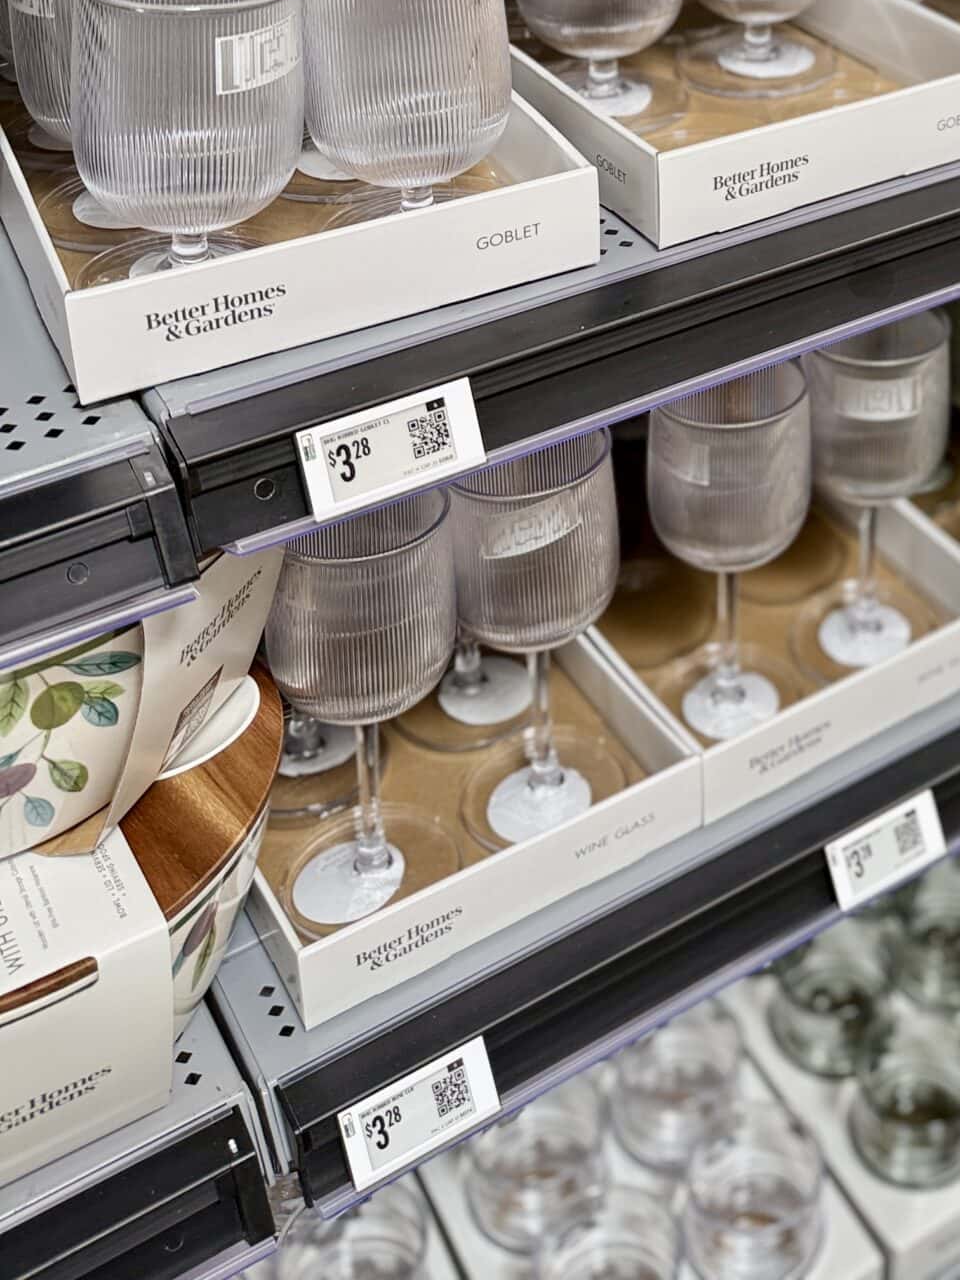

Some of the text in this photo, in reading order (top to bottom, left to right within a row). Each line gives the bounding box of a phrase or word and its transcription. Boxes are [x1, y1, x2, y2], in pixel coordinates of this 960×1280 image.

[712, 153, 810, 192] Better Homes
[476, 222, 541, 250] GOBLET
[144, 283, 287, 332] Better Homes
[574, 812, 656, 861] WINE GLASS
[354, 904, 463, 967] Better Homes
[29, 1065, 113, 1108] Homes
